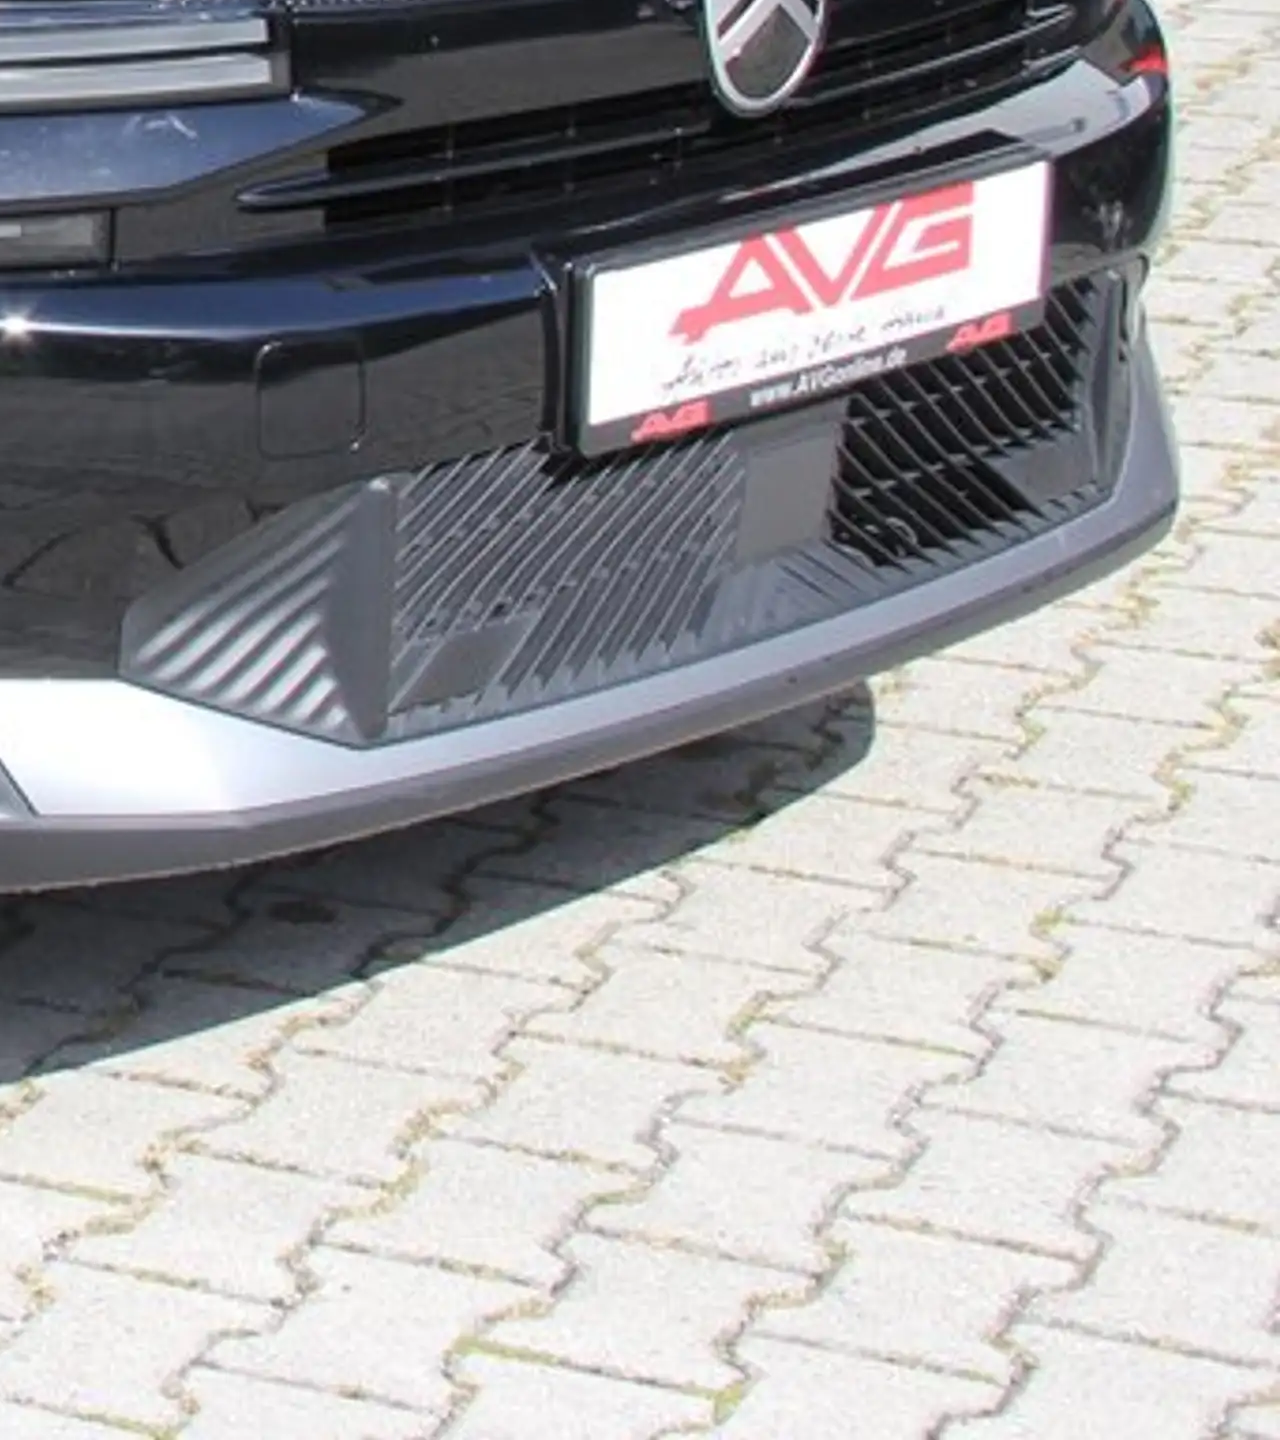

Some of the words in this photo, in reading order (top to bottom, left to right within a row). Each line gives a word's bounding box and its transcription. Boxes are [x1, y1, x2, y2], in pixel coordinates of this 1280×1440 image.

[668, 180, 975, 344] AVG
[947, 313, 1015, 352] AVG
[631, 400, 713, 444] AVG
